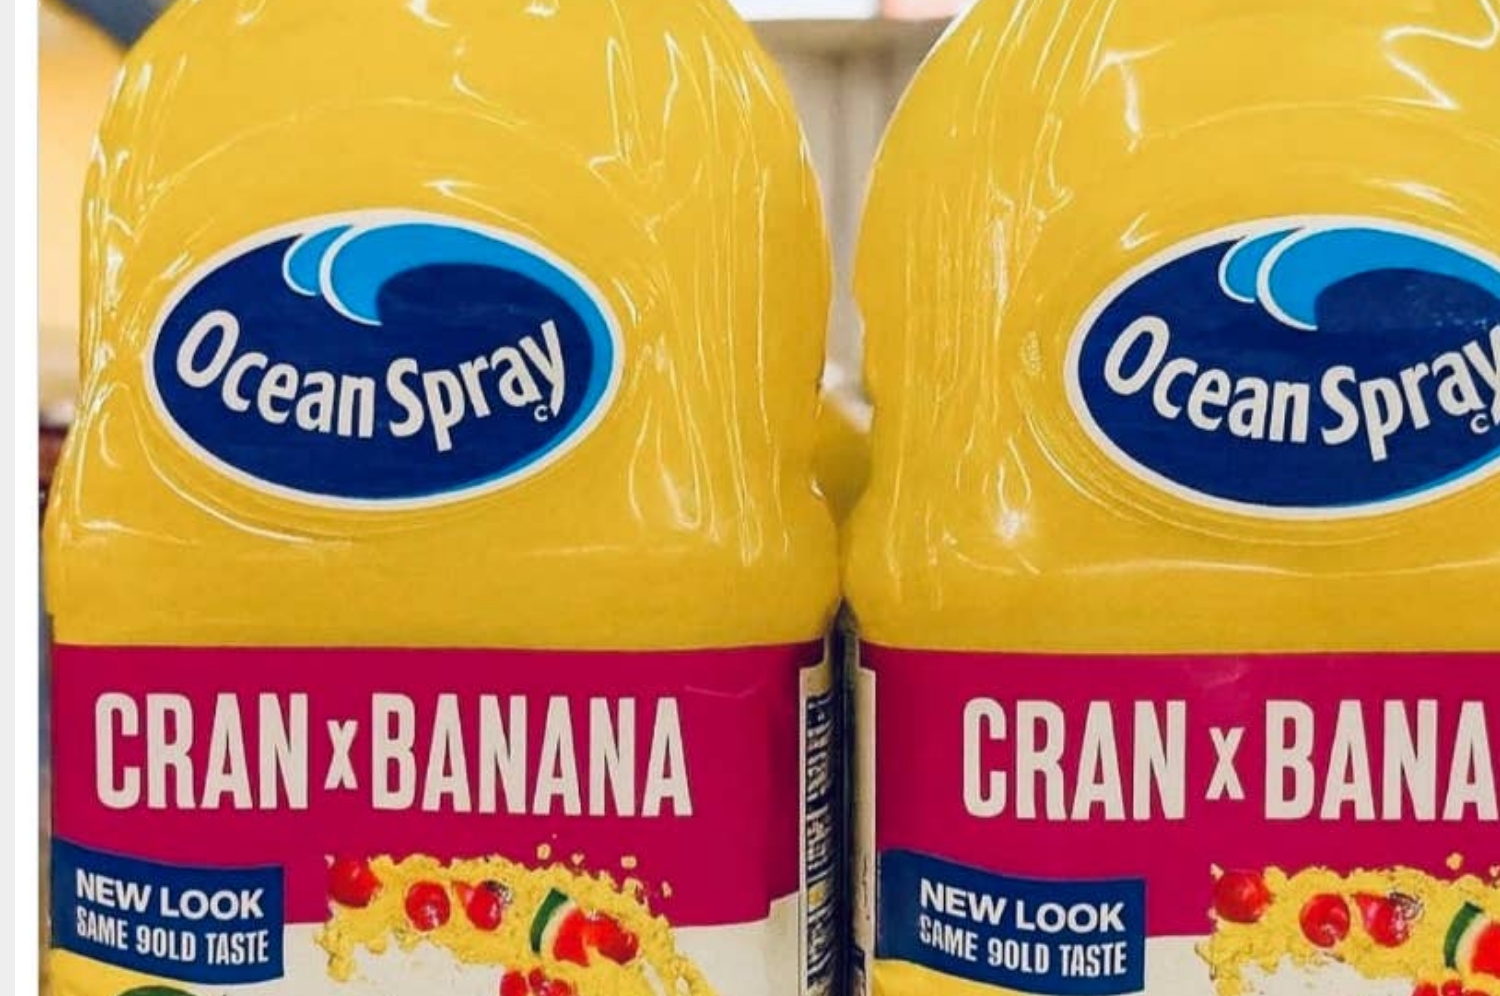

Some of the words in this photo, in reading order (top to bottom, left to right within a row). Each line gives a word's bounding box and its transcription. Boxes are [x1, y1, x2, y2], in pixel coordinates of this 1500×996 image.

[175, 308, 376, 439] Ocean
[385, 318, 567, 453] Spray
[1102, 314, 1310, 444] Ocean
[95, 691, 309, 811] CRAN
[371, 691, 694, 818] BANANA
[962, 697, 1188, 822] CRAN
[1263, 698, 1500, 822] BANA
[76, 868, 152, 913] NEW
[160, 886, 264, 920] LOOK
[76, 905, 129, 950] SAME
[205, 929, 269, 965] TASTE
[920, 877, 1007, 925] NEW
[1016, 900, 1125, 933] LOOK
[1059, 941, 1128, 977] TASTE
